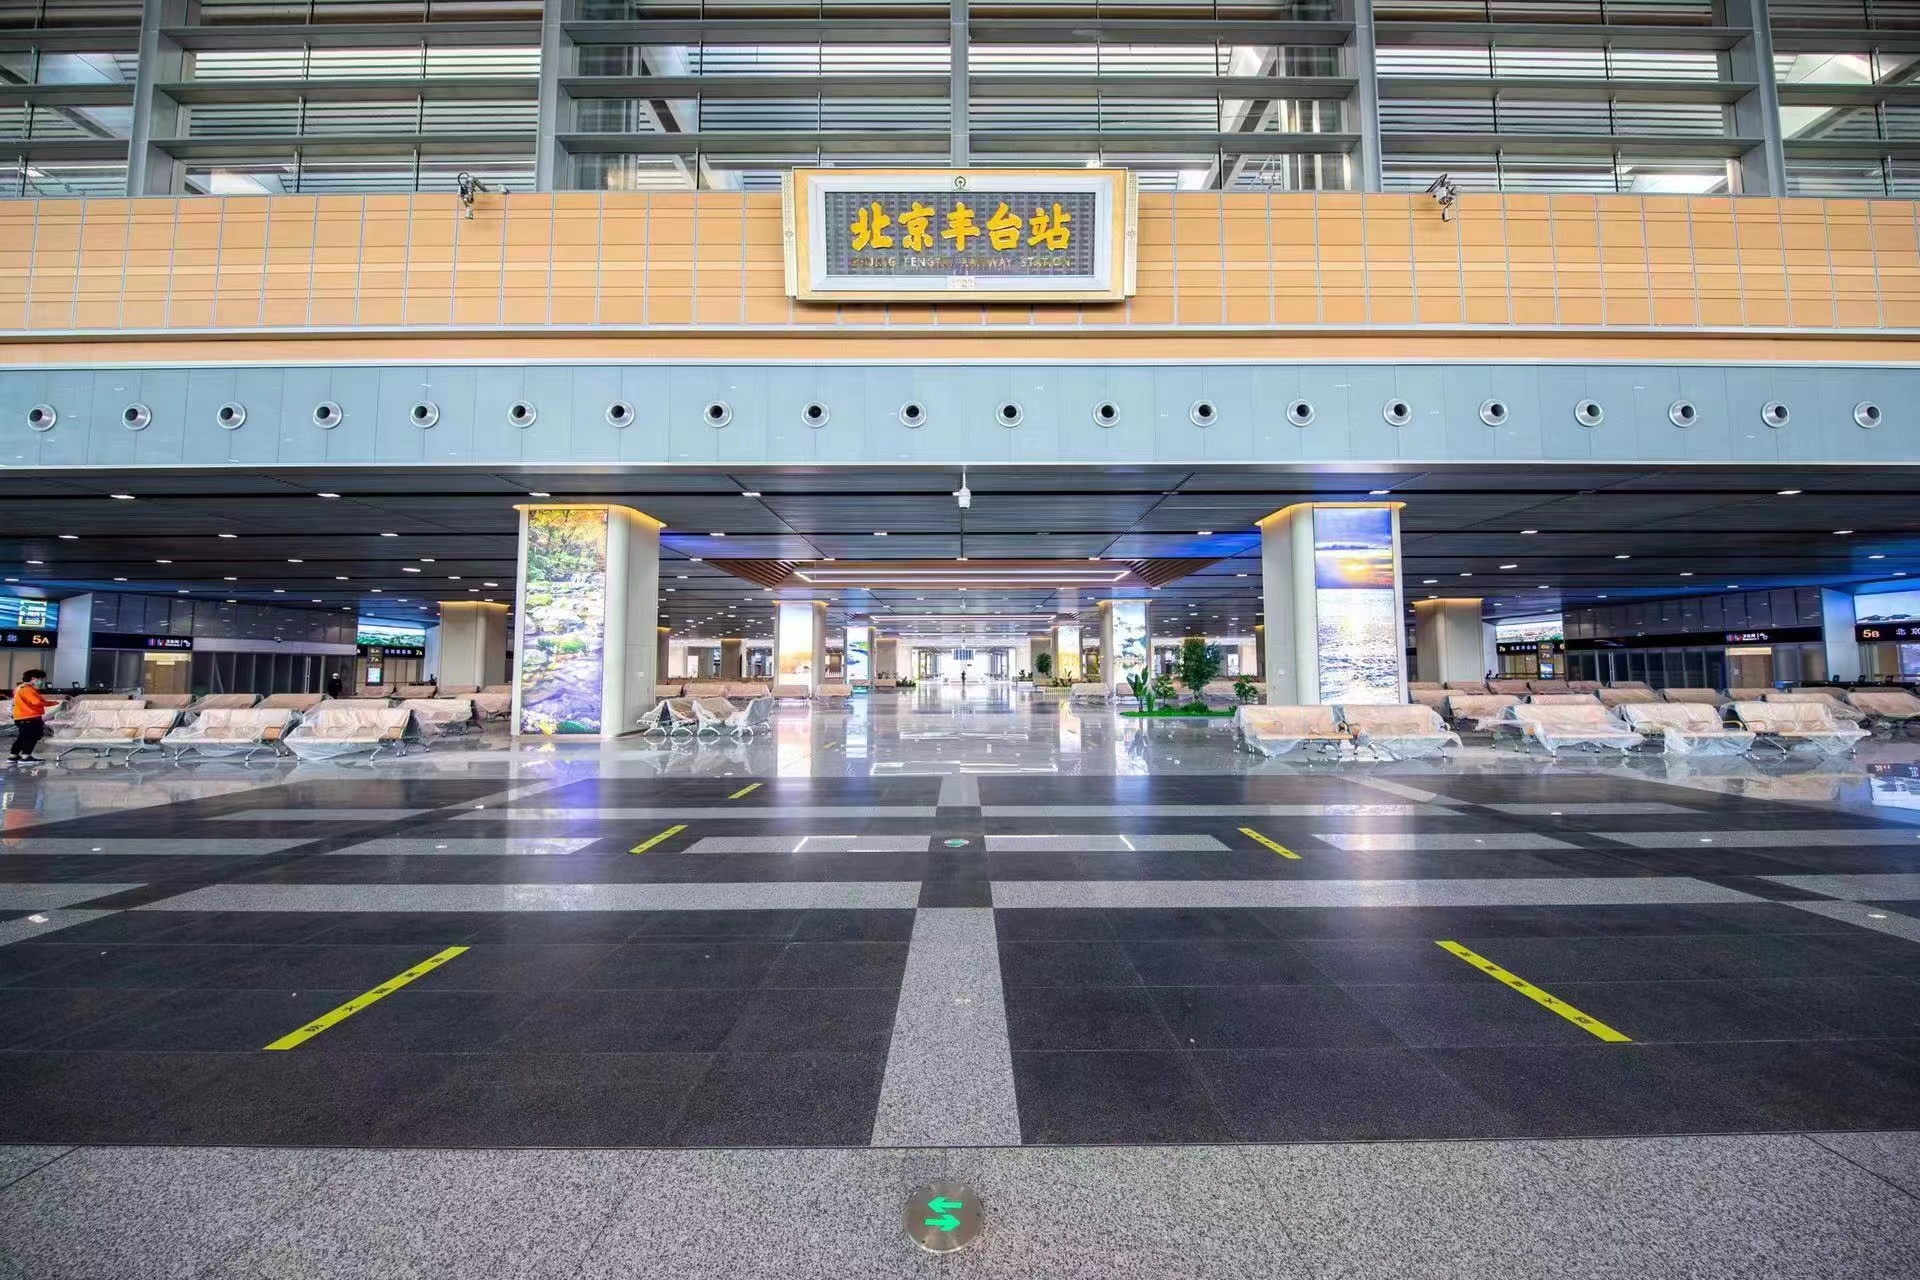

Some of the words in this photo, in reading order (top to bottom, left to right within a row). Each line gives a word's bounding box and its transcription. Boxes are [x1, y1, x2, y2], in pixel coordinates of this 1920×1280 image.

[850, 201, 1072, 252] 北京丰台站
[1863, 629, 1880, 638] 5B
[32, 635, 50, 644] 5A
